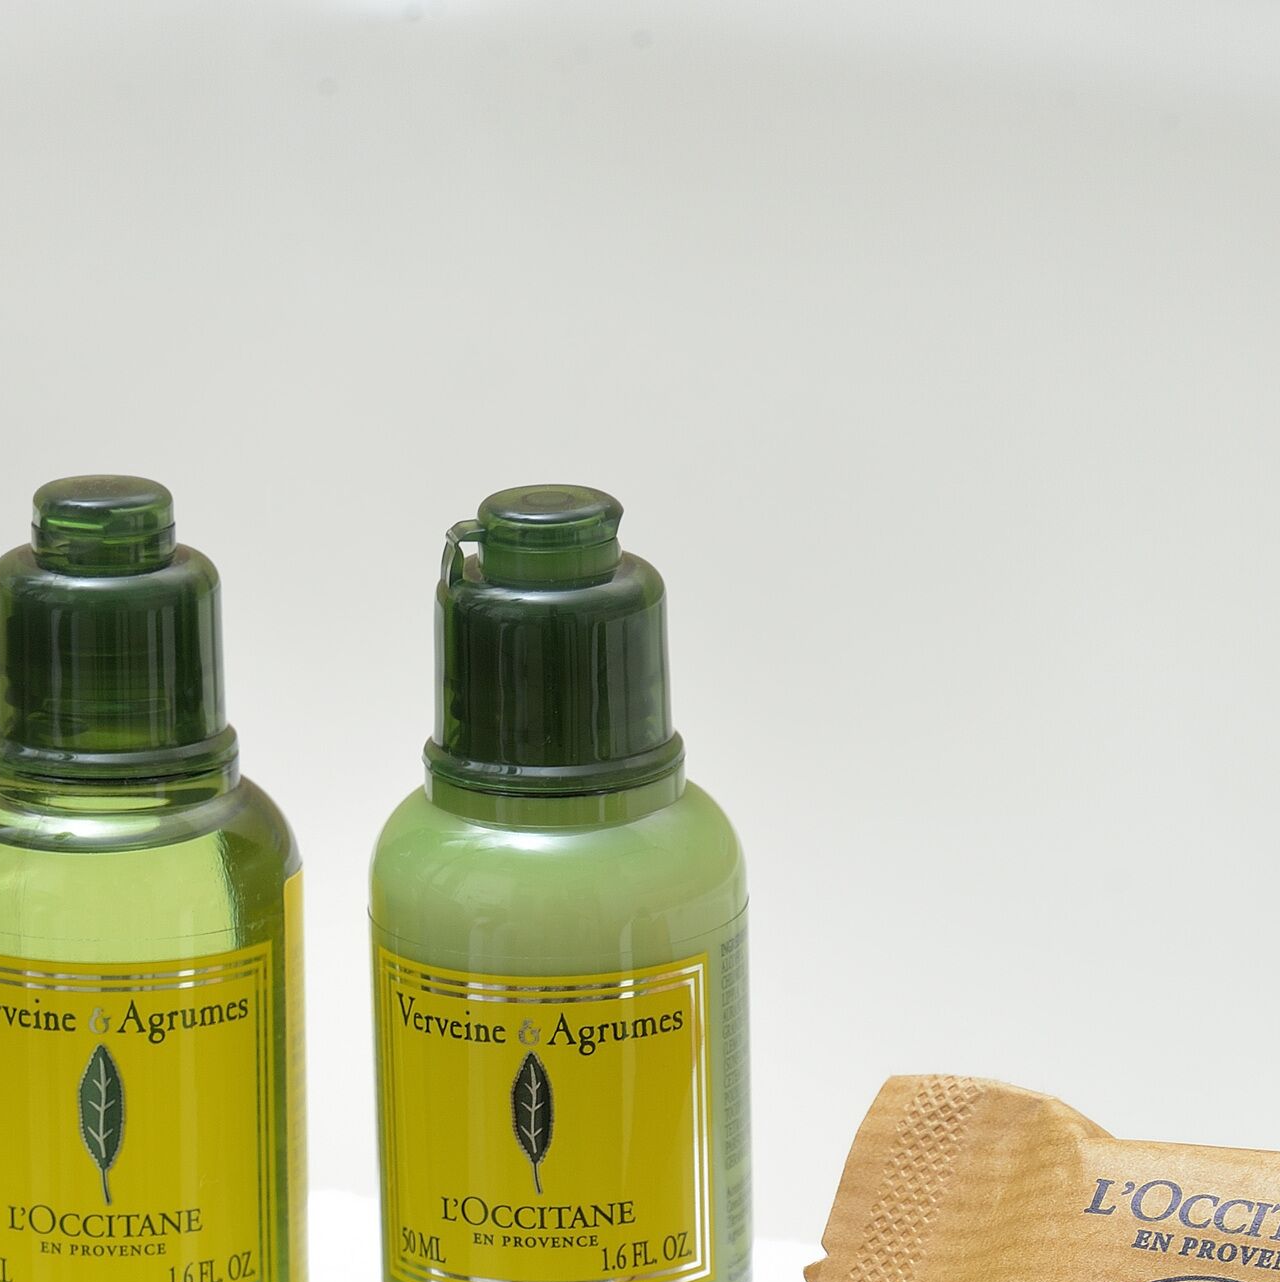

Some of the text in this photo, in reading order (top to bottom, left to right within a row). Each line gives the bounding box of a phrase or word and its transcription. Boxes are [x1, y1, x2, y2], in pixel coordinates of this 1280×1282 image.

[88, 1007, 111, 1034] &
[117, 998, 249, 1044] Agrumes
[396, 991, 684, 1056] Verveine & Agrumes
[8, 1204, 204, 1239] L'OCCITANE
[441, 1196, 636, 1230] L'OCCITANE
[41, 1241, 167, 1257] EN PROVENCE
[401, 1227, 447, 1263] 50 ML
[473, 1232, 600, 1248] EN PROVENCE
[601, 1244, 626, 1271] 1.6
[632, 1240, 658, 1269] FL.
[1131, 1229, 1175, 1253] EN
